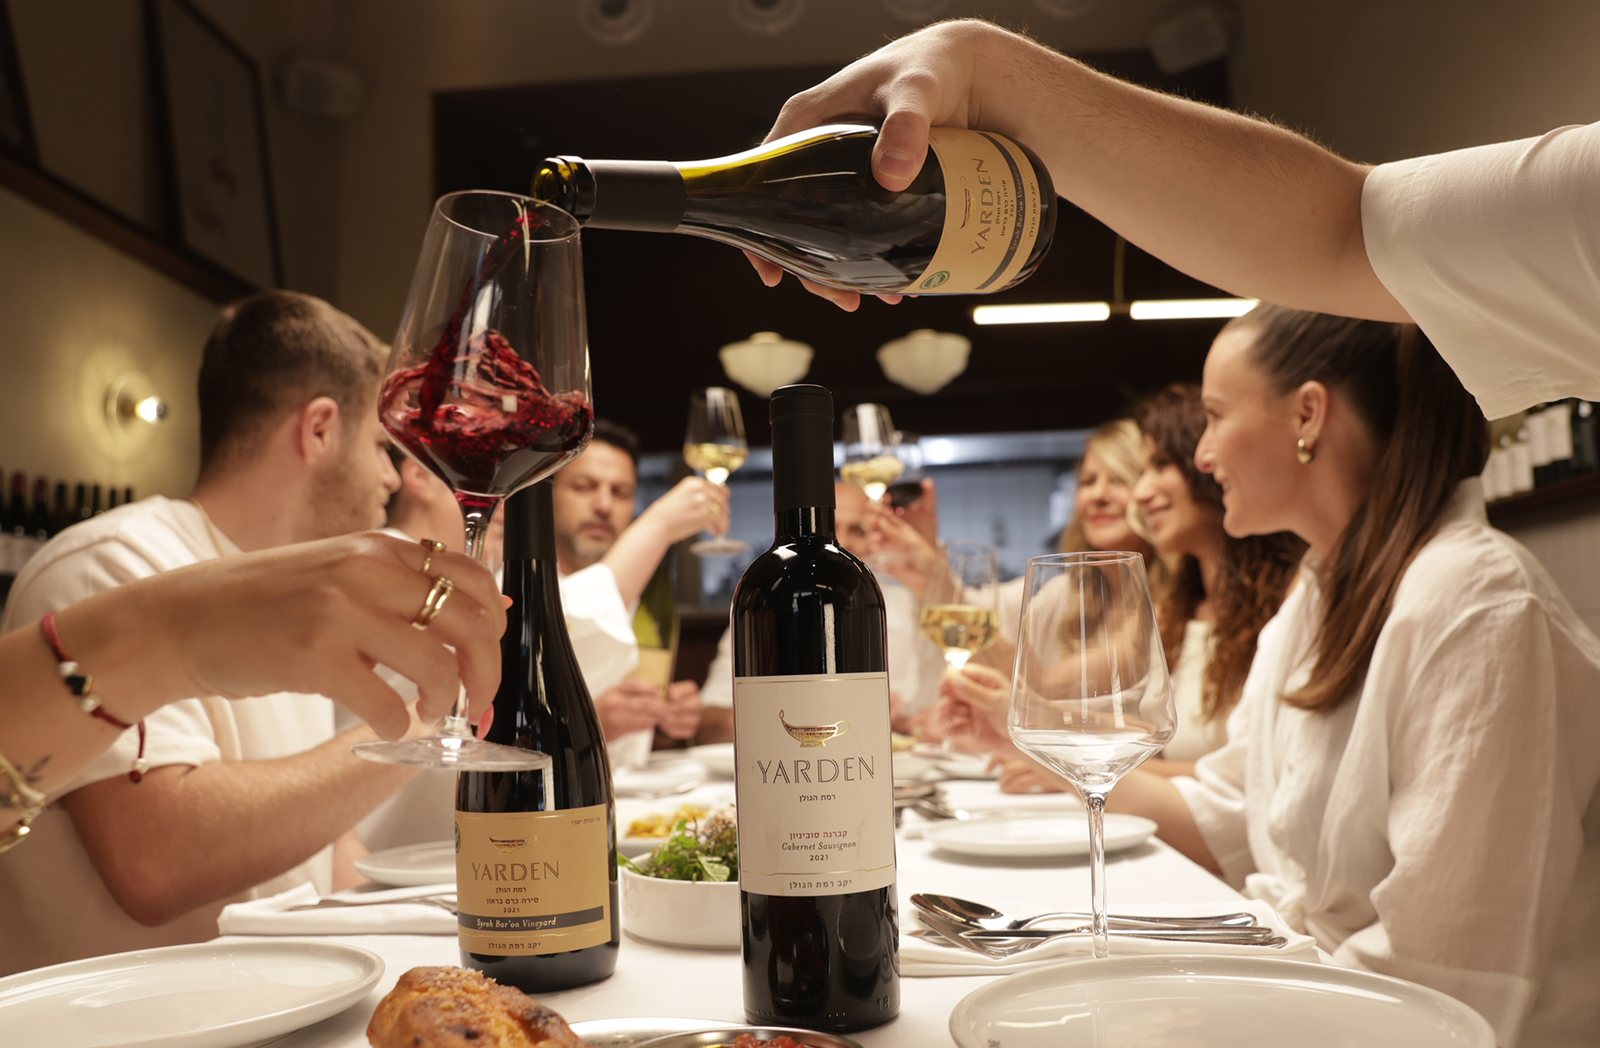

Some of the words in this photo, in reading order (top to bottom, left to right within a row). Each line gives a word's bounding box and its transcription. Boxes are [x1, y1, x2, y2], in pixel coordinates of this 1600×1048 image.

[970, 158, 993, 254] YARDEN
[757, 755, 875, 784] YARDEN
[799, 794, 818, 803] הגולן
[820, 793, 836, 801] רמת
[789, 831, 820, 841] סוביניון
[823, 829, 848, 839] קברנה
[781, 842, 816, 852] Cabernet
[818, 841, 857, 852] Sauvignon
[471, 860, 560, 881] YARDEN
[789, 881, 813, 890] הגולן
[815, 880, 834, 888] רמת
[837, 879, 852, 888] יקב
[476, 918, 494, 929] Syrah
[495, 918, 520, 928] Bar'on
[522, 916, 557, 930] Vineyard
